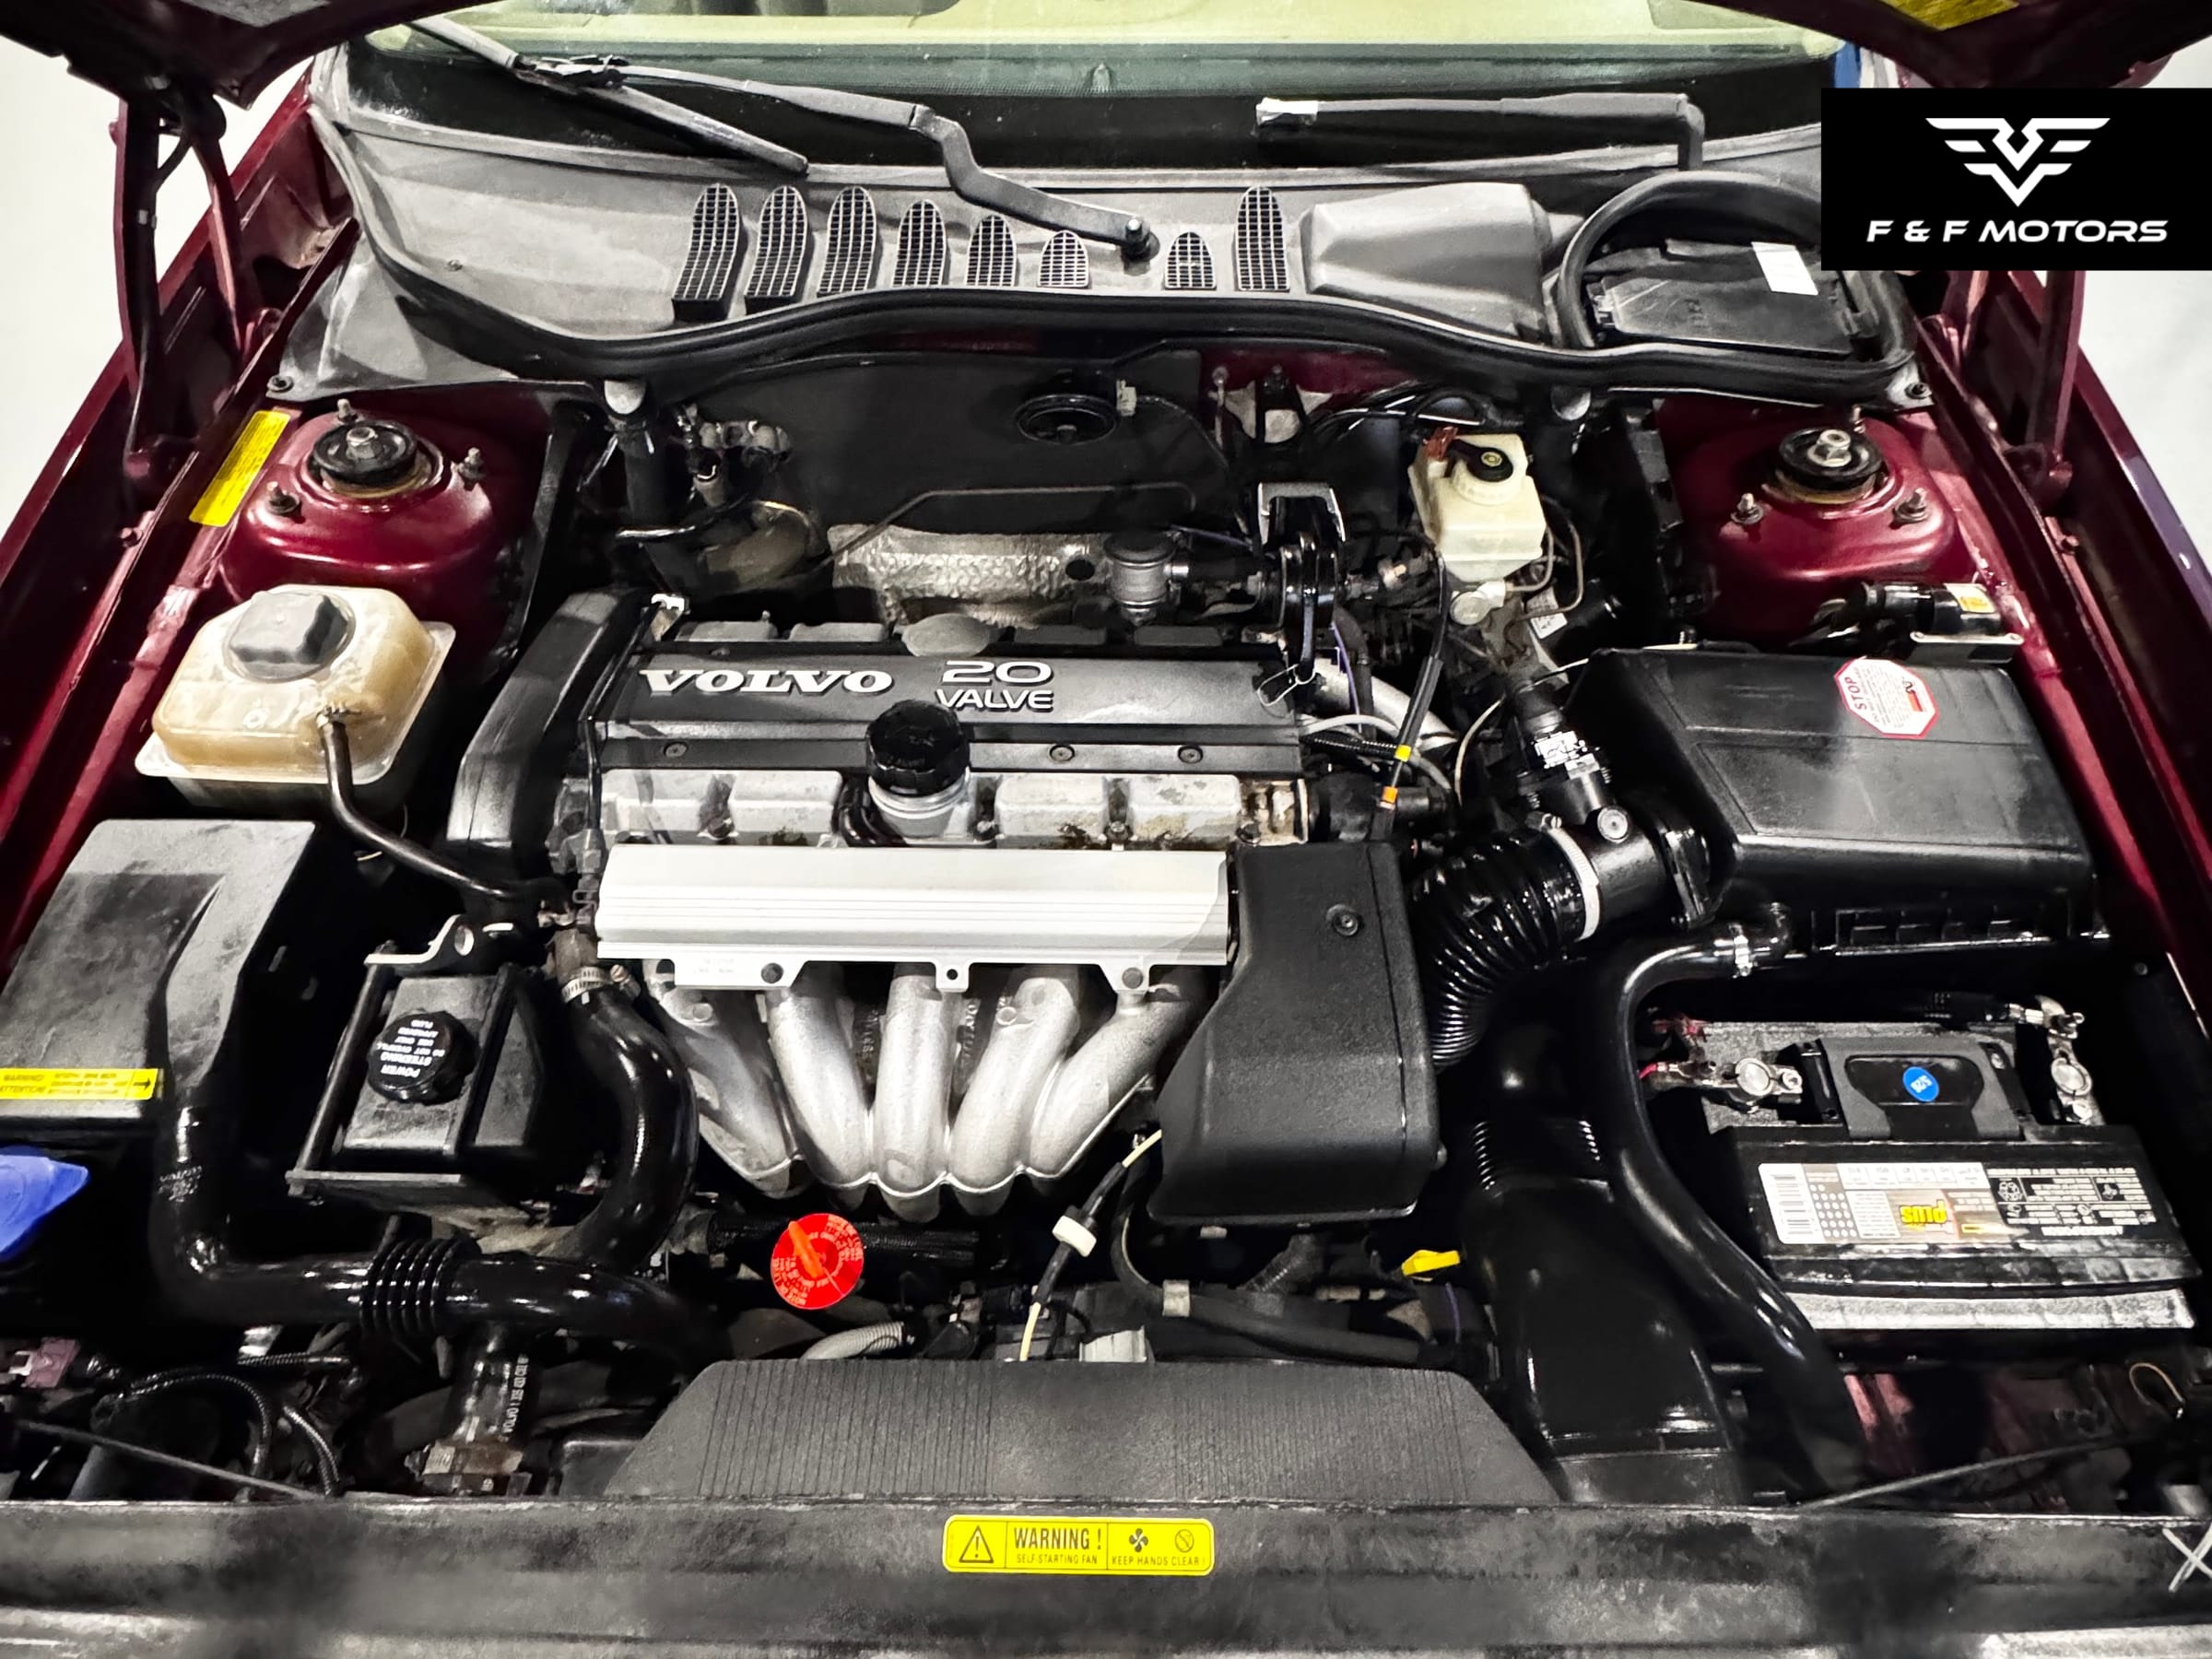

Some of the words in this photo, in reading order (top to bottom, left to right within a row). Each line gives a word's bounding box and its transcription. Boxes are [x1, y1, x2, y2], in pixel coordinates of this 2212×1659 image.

[639, 669, 894, 695] VOLVO
[941, 659, 1053, 685] 20
[935, 688, 1054, 712] VALVE
[1844, 677, 1867, 710] STOP
[1014, 1527, 1089, 1549] WARNING
[1082, 1554, 1098, 1565] FAN
[1112, 1555, 1134, 1566] KEEP
[1137, 1555, 1169, 1567] HANDS
[1171, 1556, 1199, 1567] CLEAR
